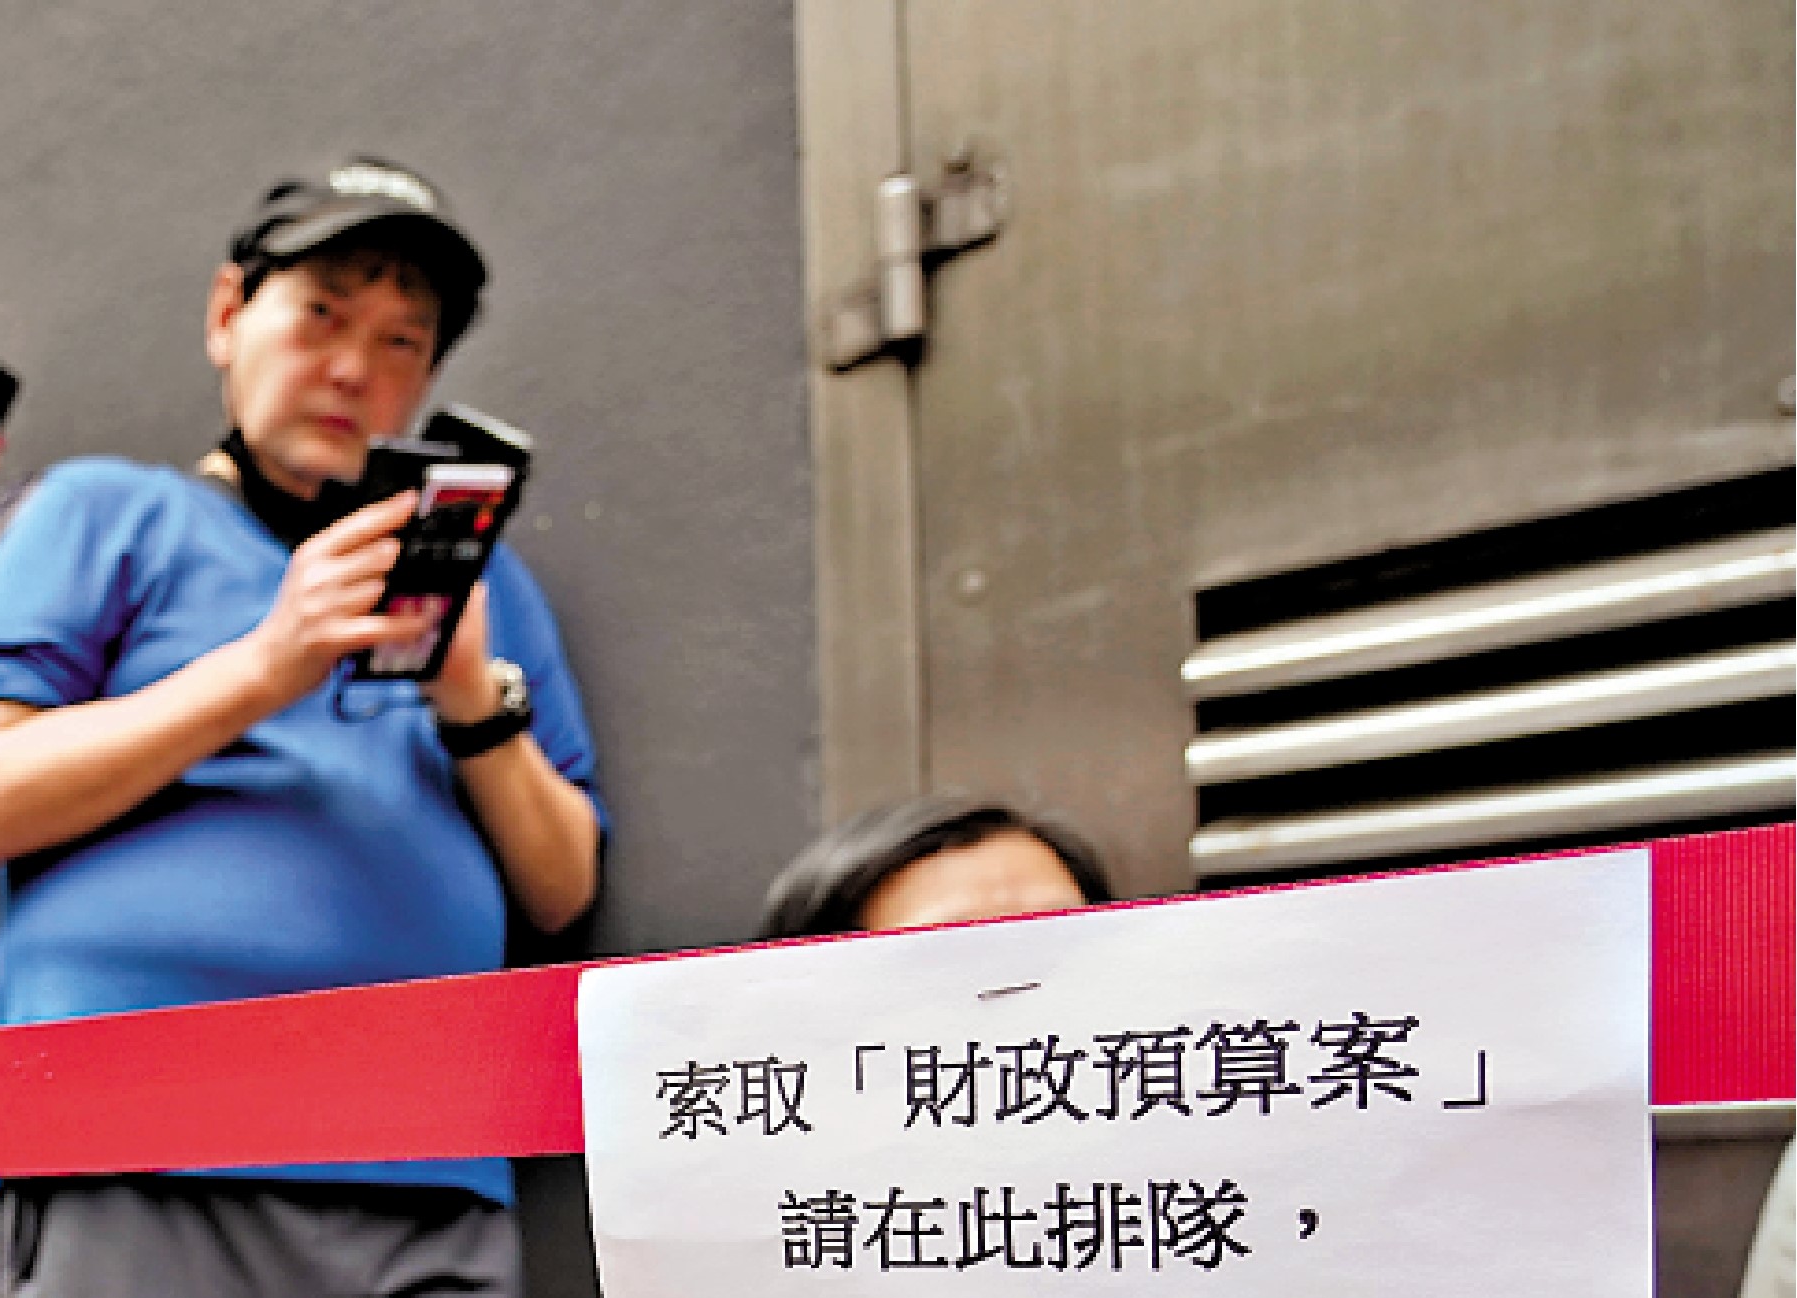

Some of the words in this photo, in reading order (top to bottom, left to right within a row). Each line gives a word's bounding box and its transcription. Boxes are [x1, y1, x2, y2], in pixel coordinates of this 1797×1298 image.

[655, 1010, 1488, 1141] 索取「財政預算案」
[776, 1176, 1322, 1273] 請在此排隊，
